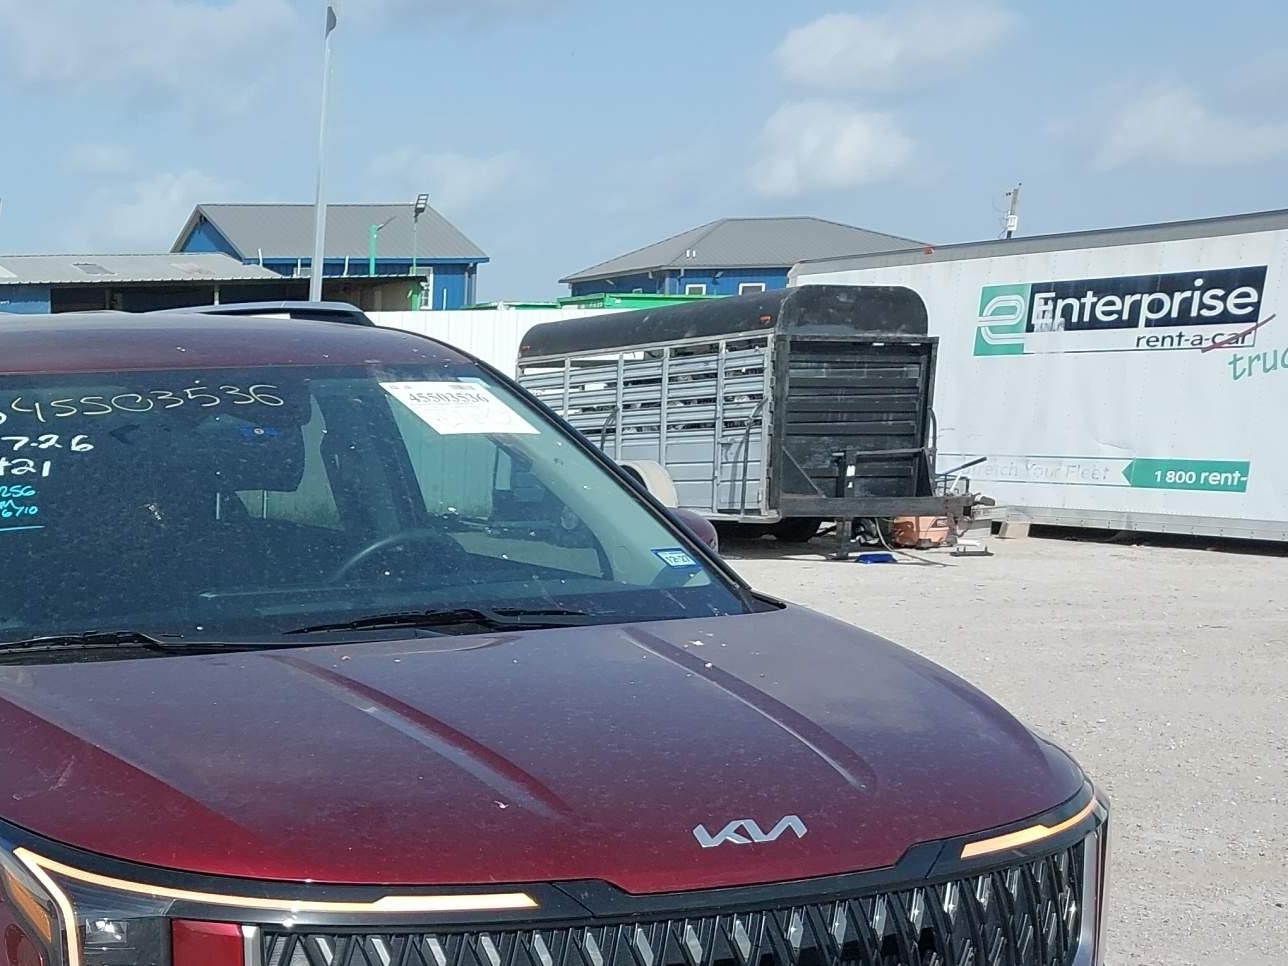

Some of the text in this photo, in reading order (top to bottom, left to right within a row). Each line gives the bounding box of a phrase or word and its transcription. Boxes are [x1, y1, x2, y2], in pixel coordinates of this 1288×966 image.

[1031, 278, 1260, 330] Enterprise
[1136, 331, 1253, 348] rent-a-car
[1154, 471, 1162, 484] 1
[1165, 470, 1197, 485] 800
[692, 814, 808, 848] KIA
